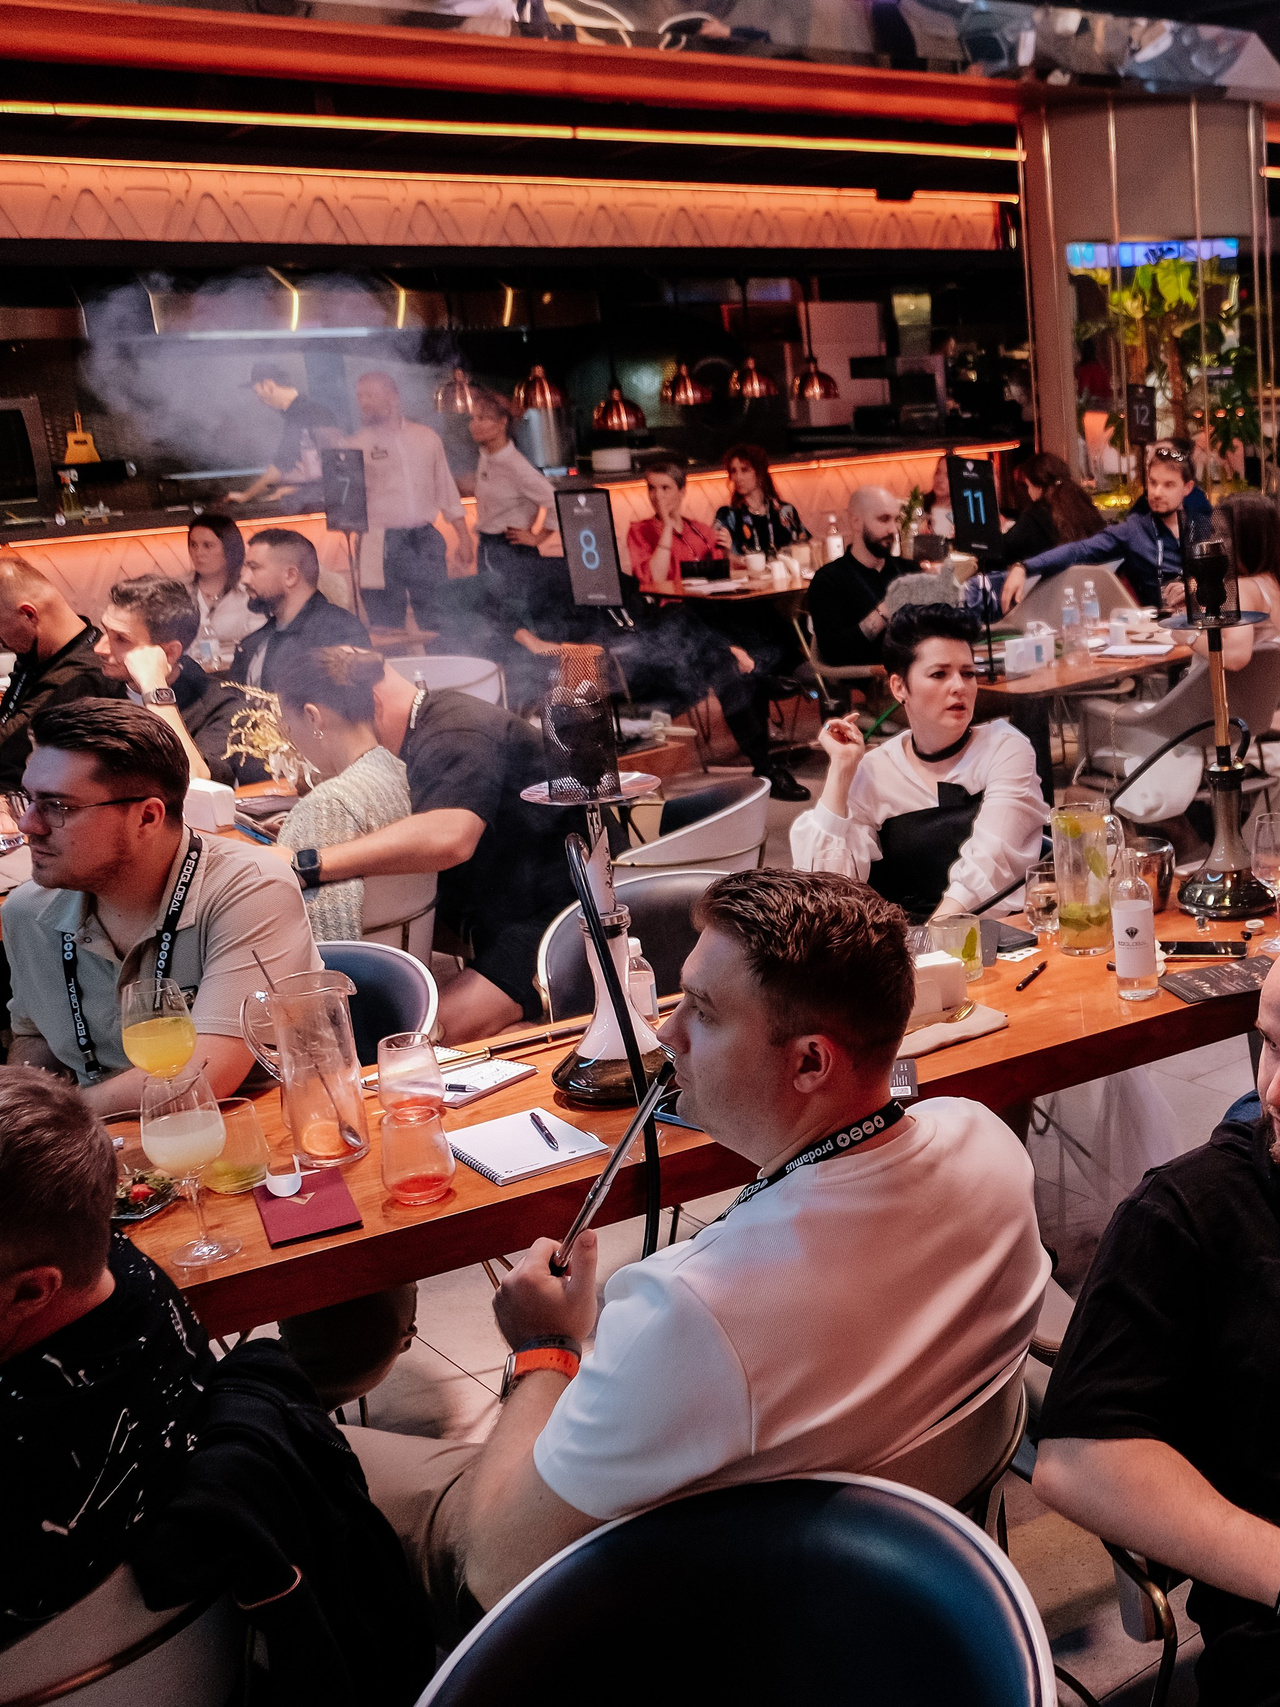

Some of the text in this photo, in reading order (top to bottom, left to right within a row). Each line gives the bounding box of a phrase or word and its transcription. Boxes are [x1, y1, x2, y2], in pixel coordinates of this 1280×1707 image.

[1133, 404, 1150, 426] 12
[337, 476, 351, 505] 7
[963, 489, 986, 525] 11
[579, 529, 600, 570] 8
[168, 858, 196, 916] EDGLOBAL
[66, 977, 87, 1037] EDGLOBAL
[785, 1139, 834, 1174] prodamus
